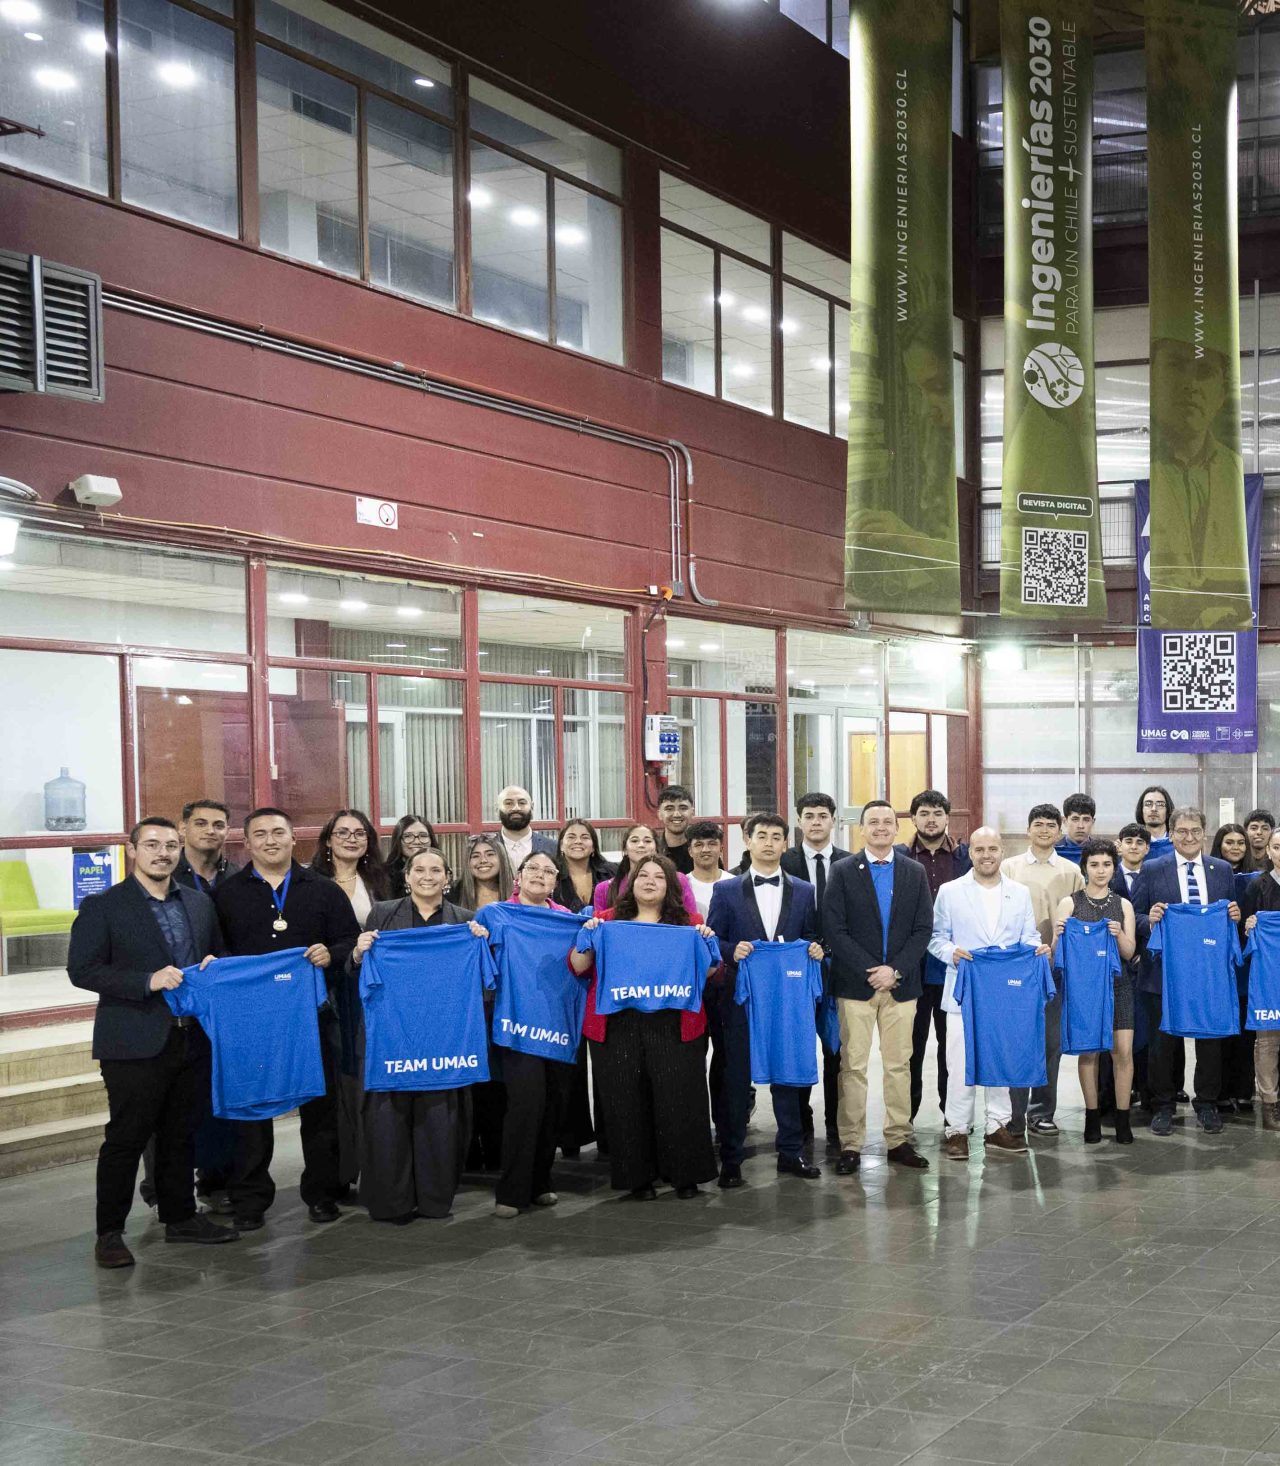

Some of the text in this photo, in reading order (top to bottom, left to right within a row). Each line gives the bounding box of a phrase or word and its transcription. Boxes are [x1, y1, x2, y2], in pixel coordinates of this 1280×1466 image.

[1062, 20, 1078, 156] SUSTENTABLE
[896, 68, 908, 322] WWW.INGENIERIAS2030.CL
[1064, 187, 1079, 243] CHILE
[1192, 122, 1205, 360] WWW.INGENIERIAS2030.CL
[1065, 250, 1079, 277] UN
[1065, 284, 1079, 334] PARA
[1023, 499, 1087, 511] REVISTA DIGITAL
[1141, 729, 1167, 737] UMAG
[80, 866, 104, 875] PAPEL
[611, 986, 650, 1000] TEAM
[529, 1026, 569, 1045] UMAG
[384, 1055, 478, 1073] TEAM UMAG
